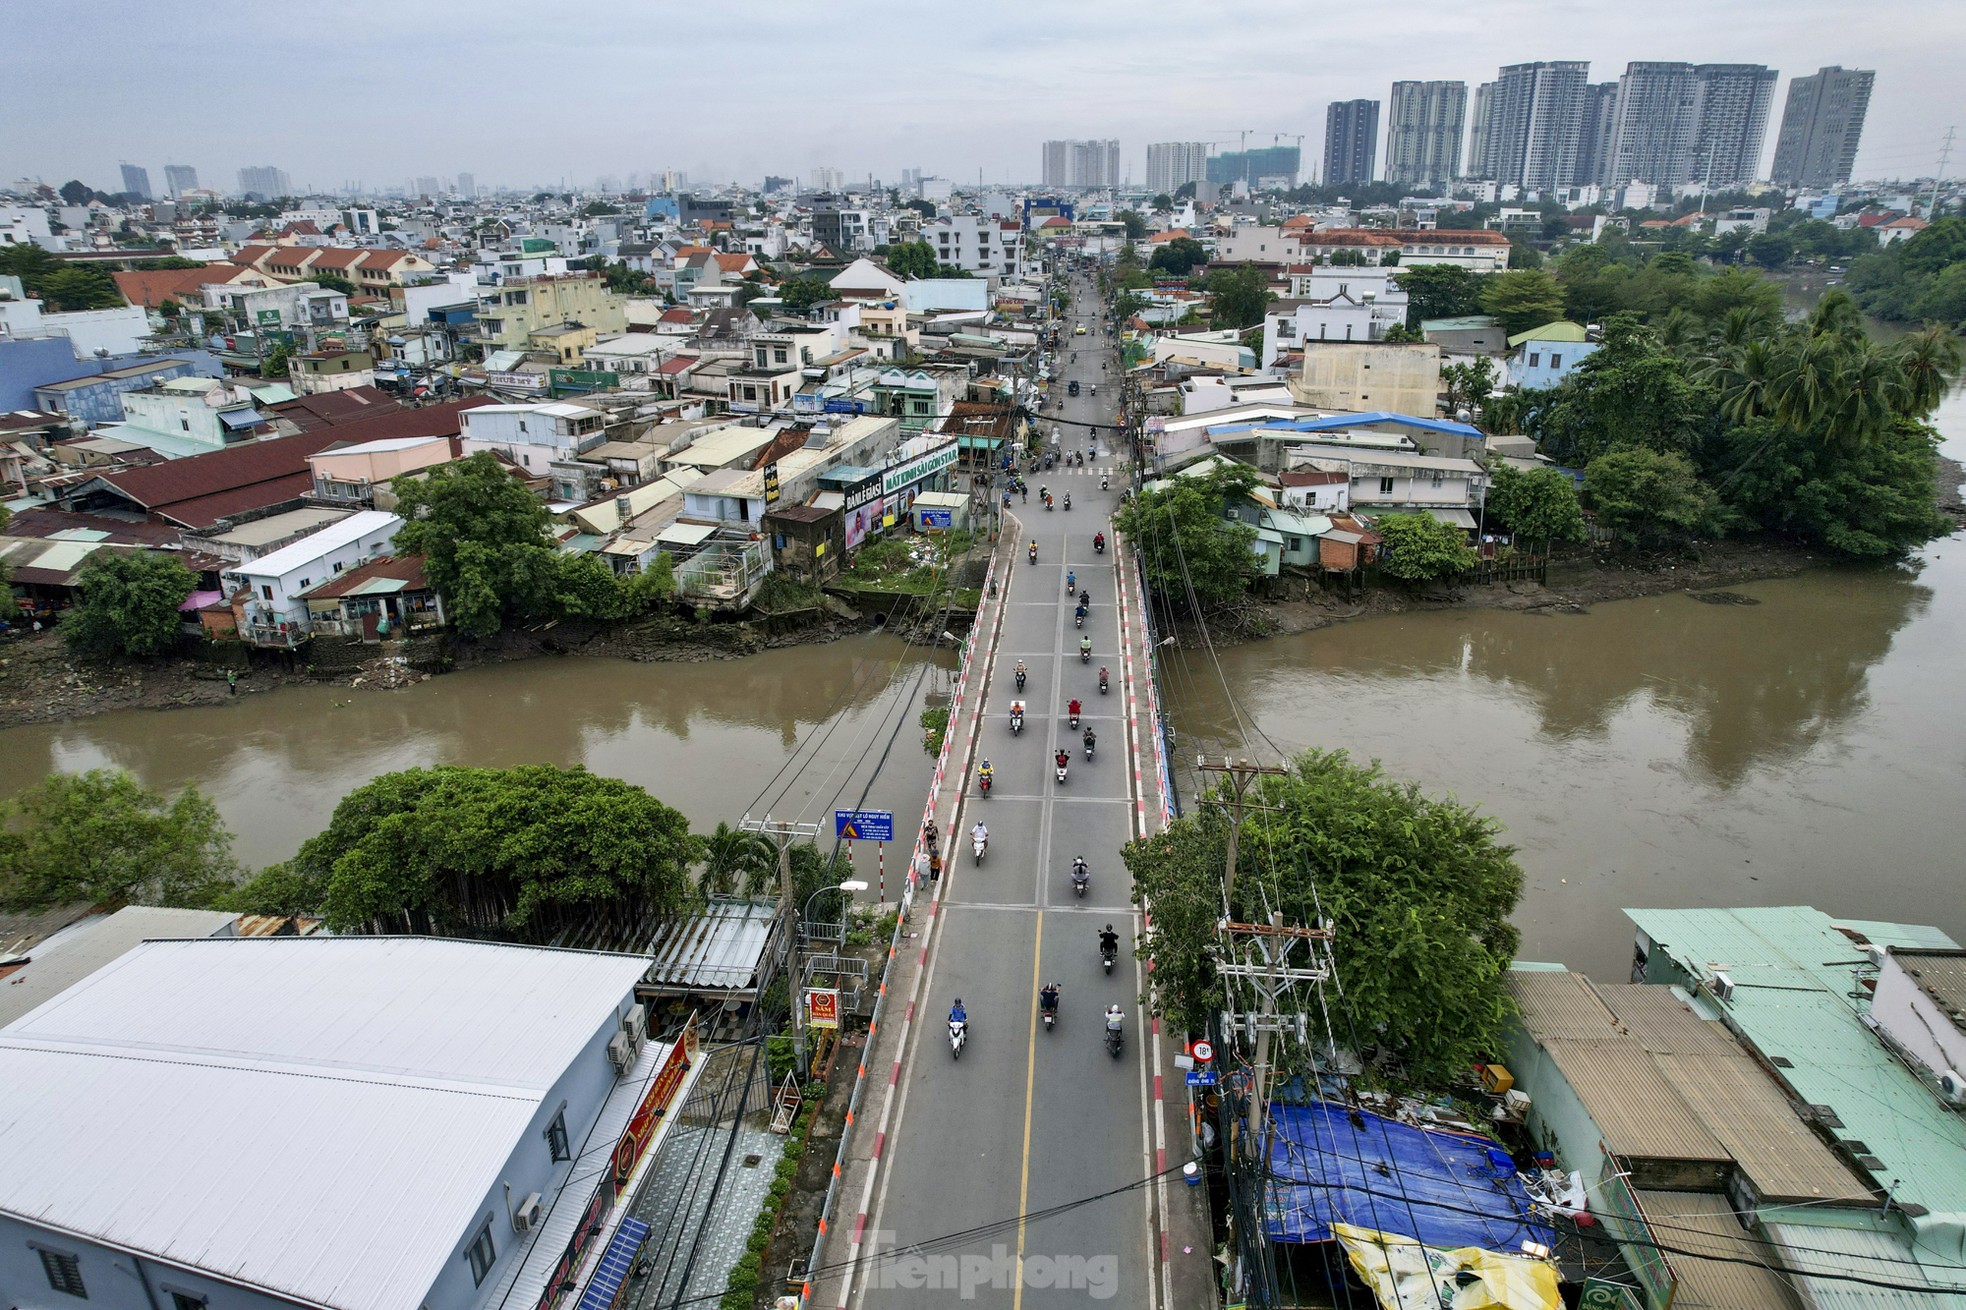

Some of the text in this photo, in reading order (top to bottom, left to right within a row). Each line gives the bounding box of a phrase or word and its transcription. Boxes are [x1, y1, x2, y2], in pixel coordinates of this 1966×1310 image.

[917, 461, 927, 476] SÀI
[928, 456, 941, 471] GÒN
[941, 450, 958, 466] STAR
[846, 490, 860, 510] BÁN
[860, 485, 866, 502] LẺ
[866, 482, 876, 500] GIÁ
